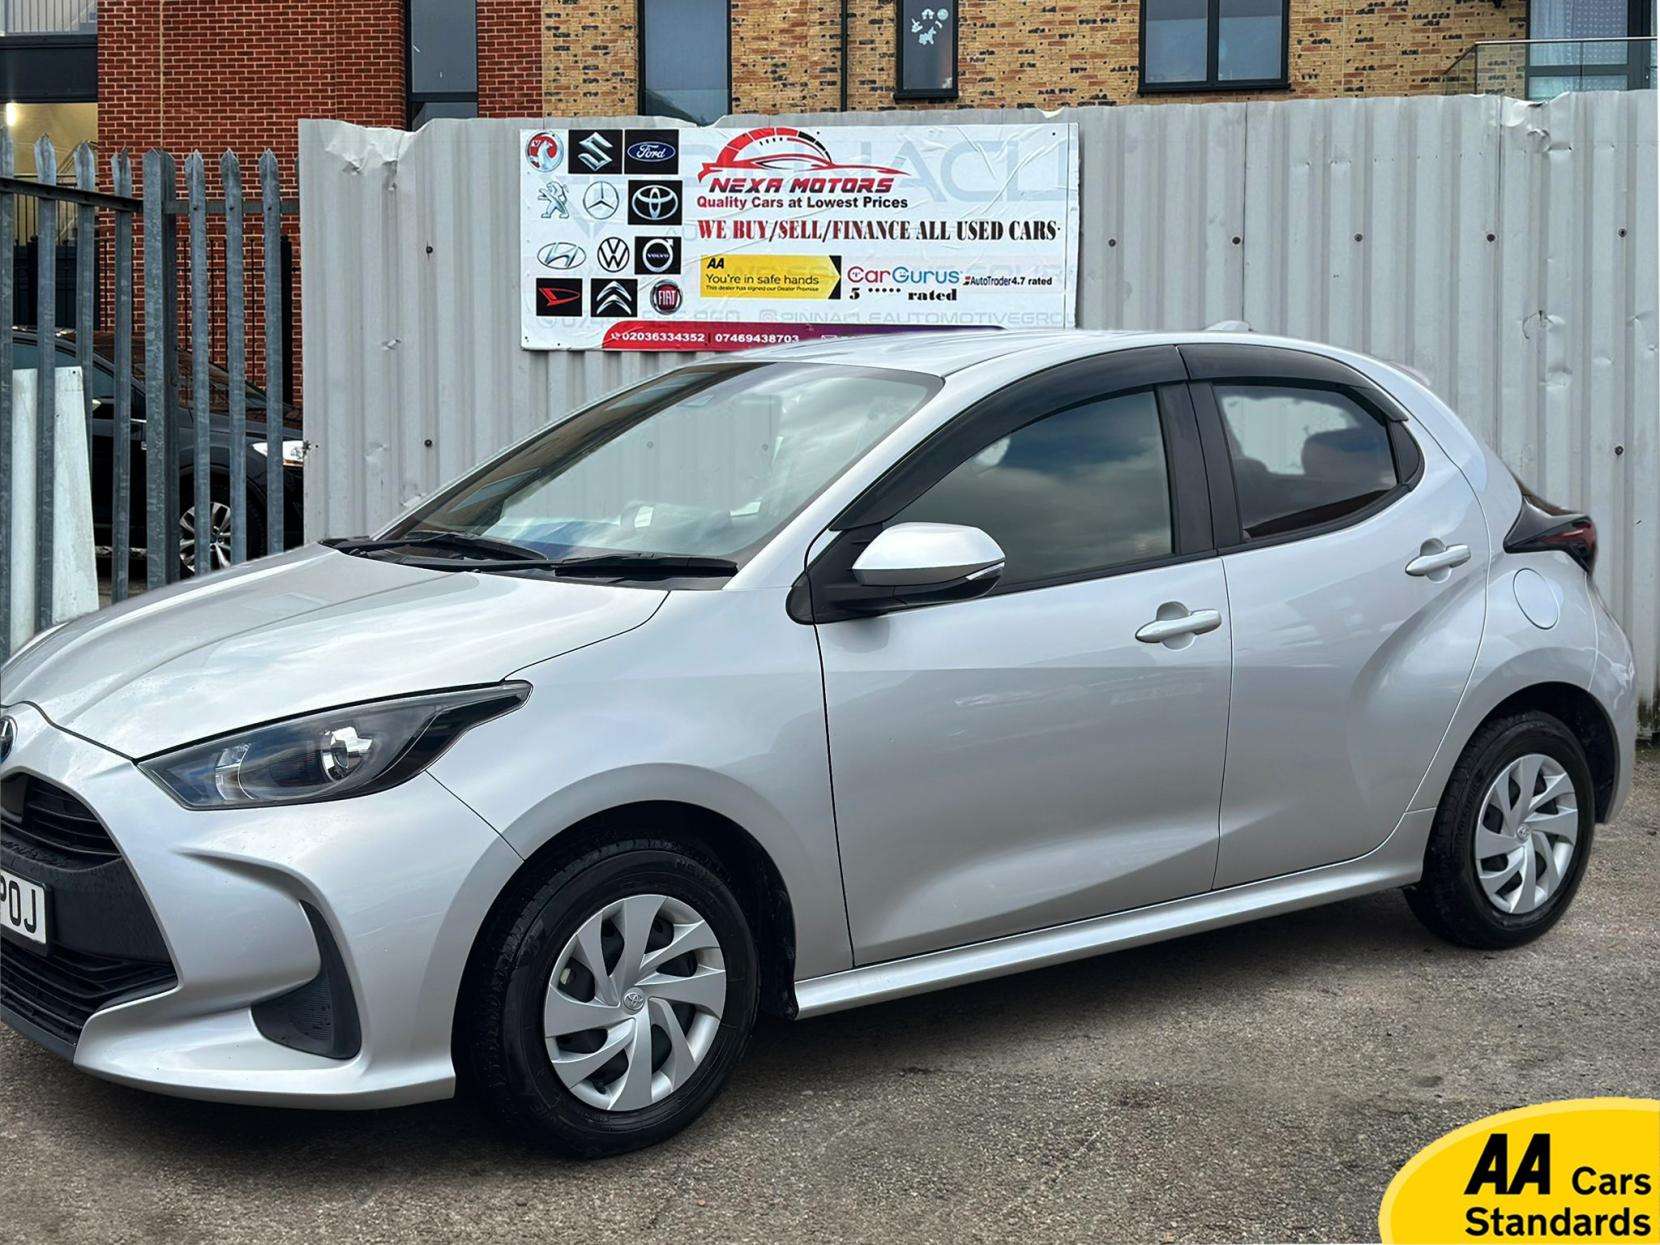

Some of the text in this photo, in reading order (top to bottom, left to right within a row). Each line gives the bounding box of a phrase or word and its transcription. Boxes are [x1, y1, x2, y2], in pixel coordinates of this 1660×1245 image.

[636, 144, 666, 158] Ford
[708, 178, 895, 193] NEXA MOTORS
[696, 195, 908, 210] Quality Cars at Lowest Prices
[697, 219, 727, 240] WE
[916, 221, 951, 240] ALL
[956, 220, 1004, 241] USED
[1008, 220, 1058, 241] CARS
[707, 257, 725, 269] AA
[706, 273, 819, 285] You're in safe hands
[847, 266, 960, 284] CarGurus
[1028, 277, 1053, 286] rated
[658, 290, 676, 306] FIAT
[849, 288, 860, 300] 5
[908, 289, 957, 301] rated
[622, 332, 800, 344] 02036334352 07469438703
